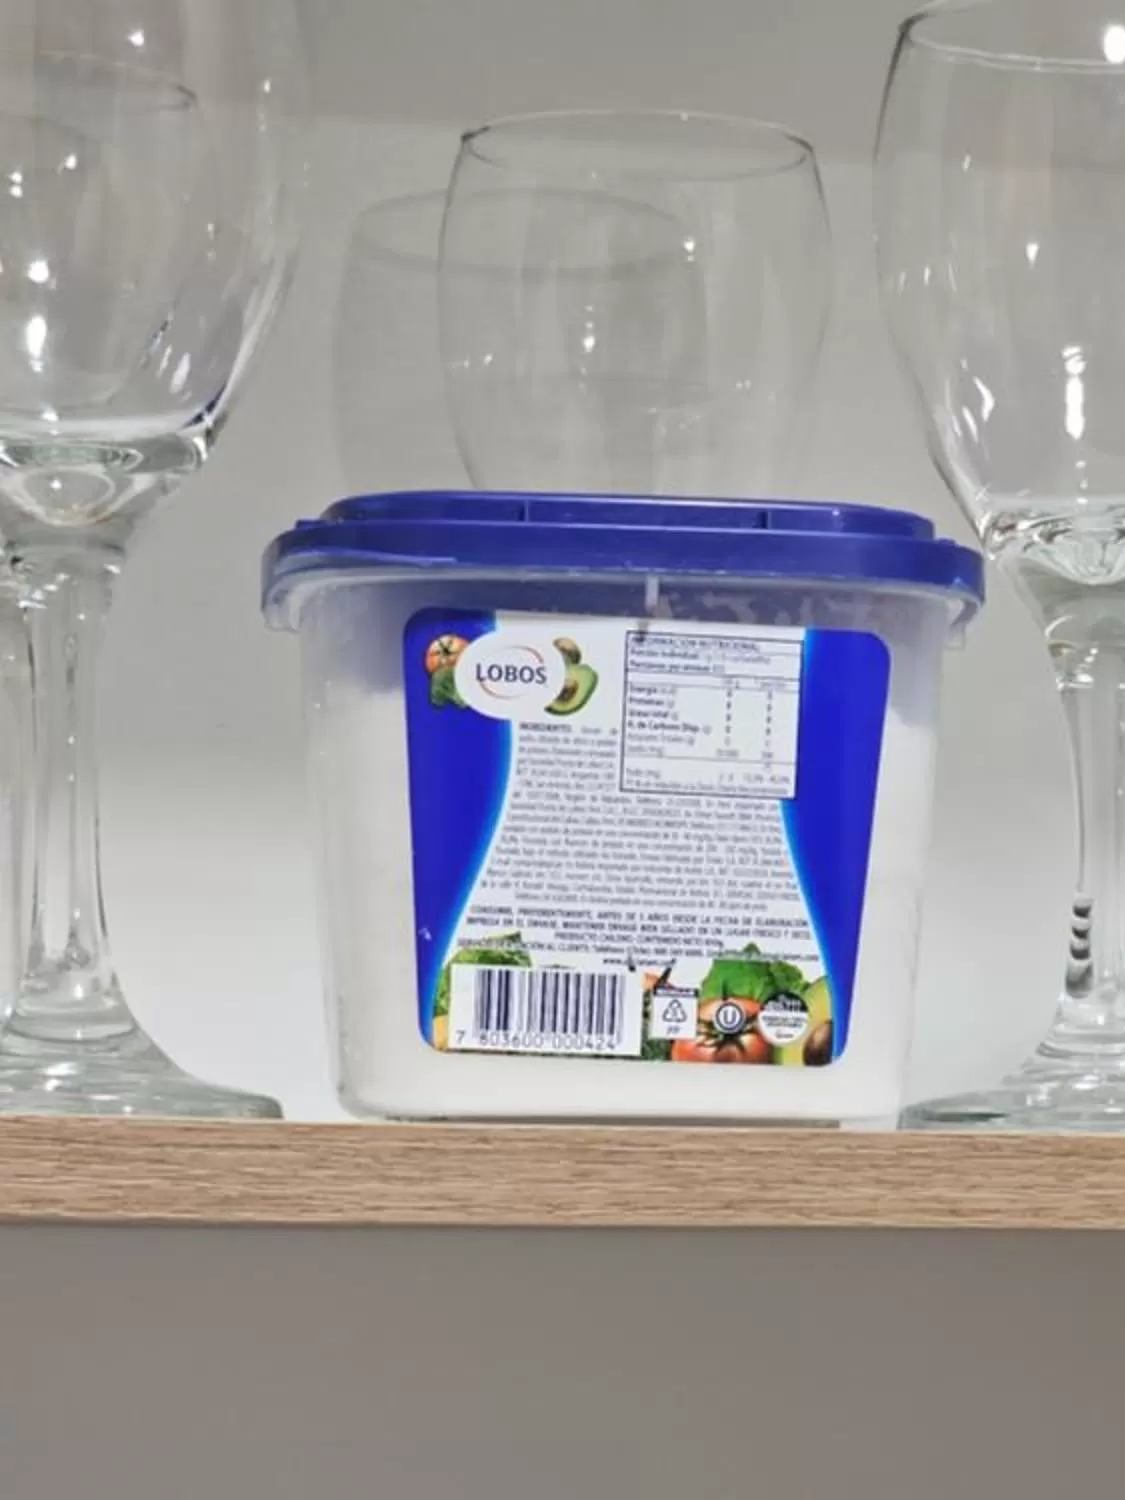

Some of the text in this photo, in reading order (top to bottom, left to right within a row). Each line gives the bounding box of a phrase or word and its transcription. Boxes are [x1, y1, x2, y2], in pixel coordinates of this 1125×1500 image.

[475, 663, 548, 685] LOBOS
[456, 1029, 615, 1050] 7 803600 000424
